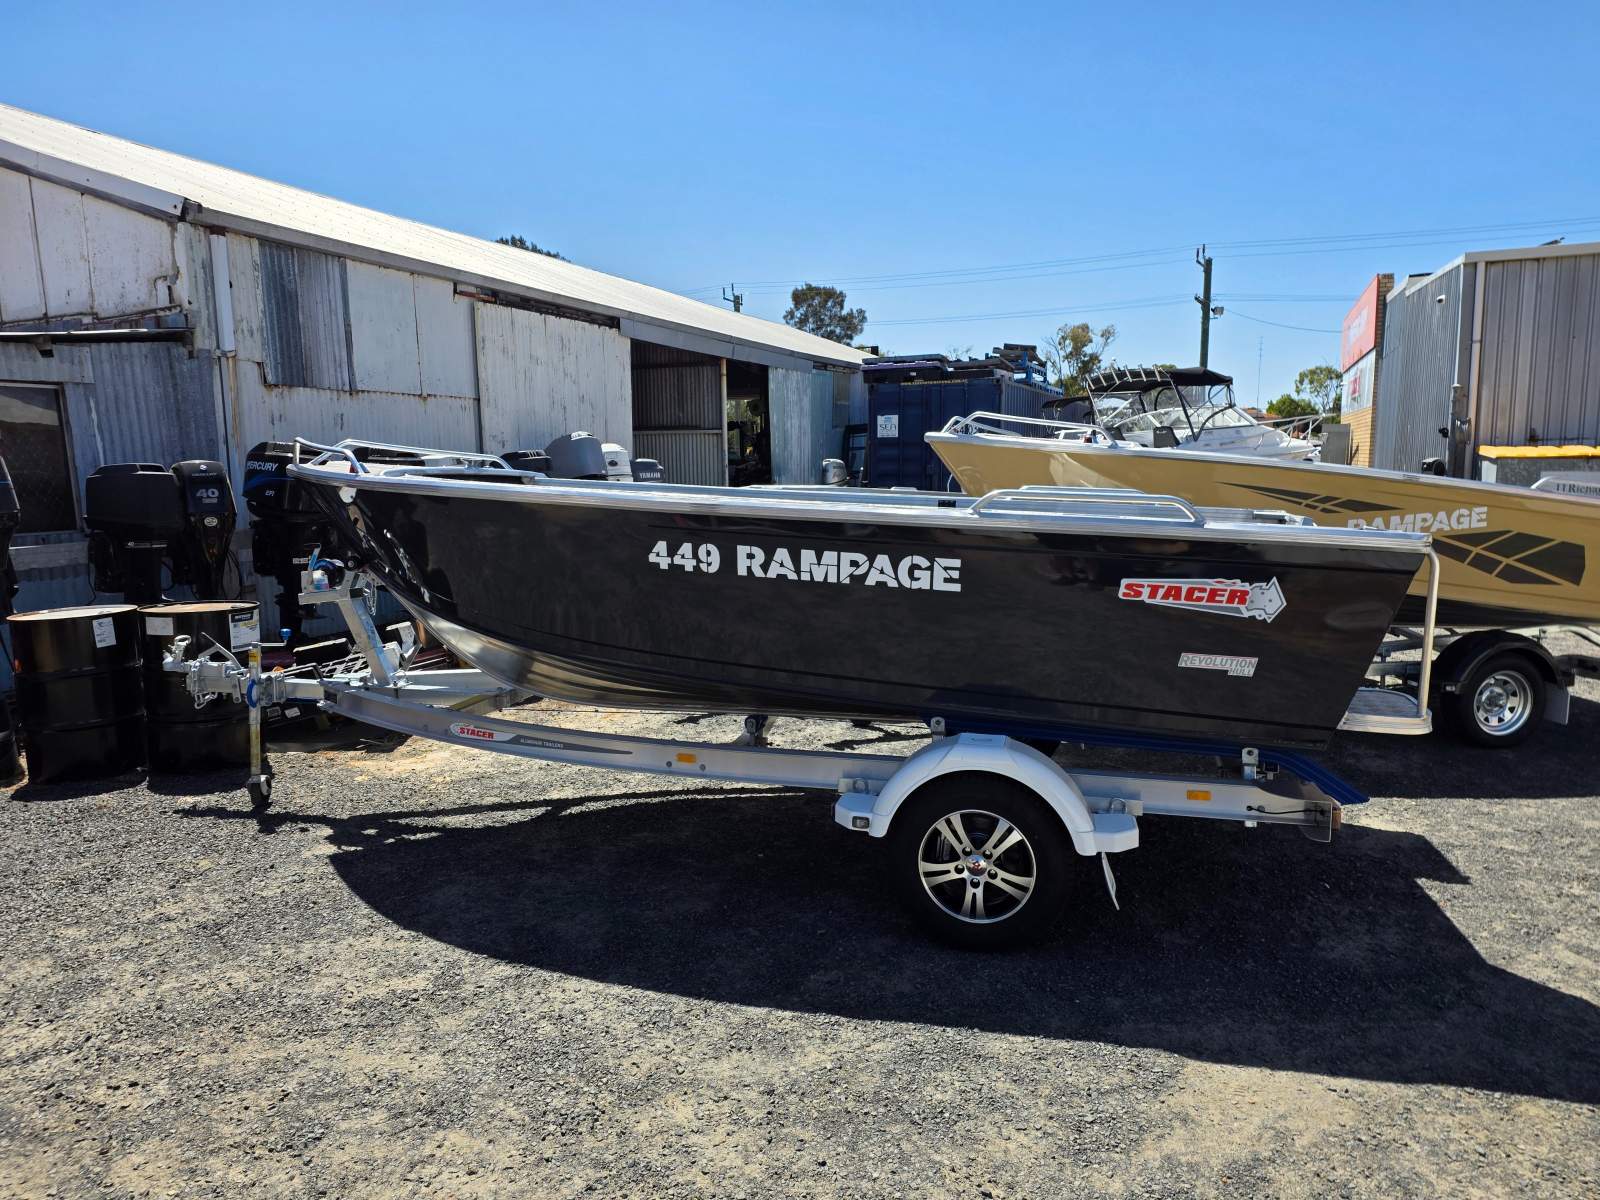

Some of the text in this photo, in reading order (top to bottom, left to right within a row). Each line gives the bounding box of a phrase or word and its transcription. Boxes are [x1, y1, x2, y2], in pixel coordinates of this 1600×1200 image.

[246, 460, 278, 472] MERCURY
[196, 488, 219, 498] 40
[648, 540, 961, 592] 449 RAMPAGE
[1122, 583, 1250, 605] STACER
[1180, 655, 1257, 669] REVOLUTION
[459, 727, 494, 739] STACER
